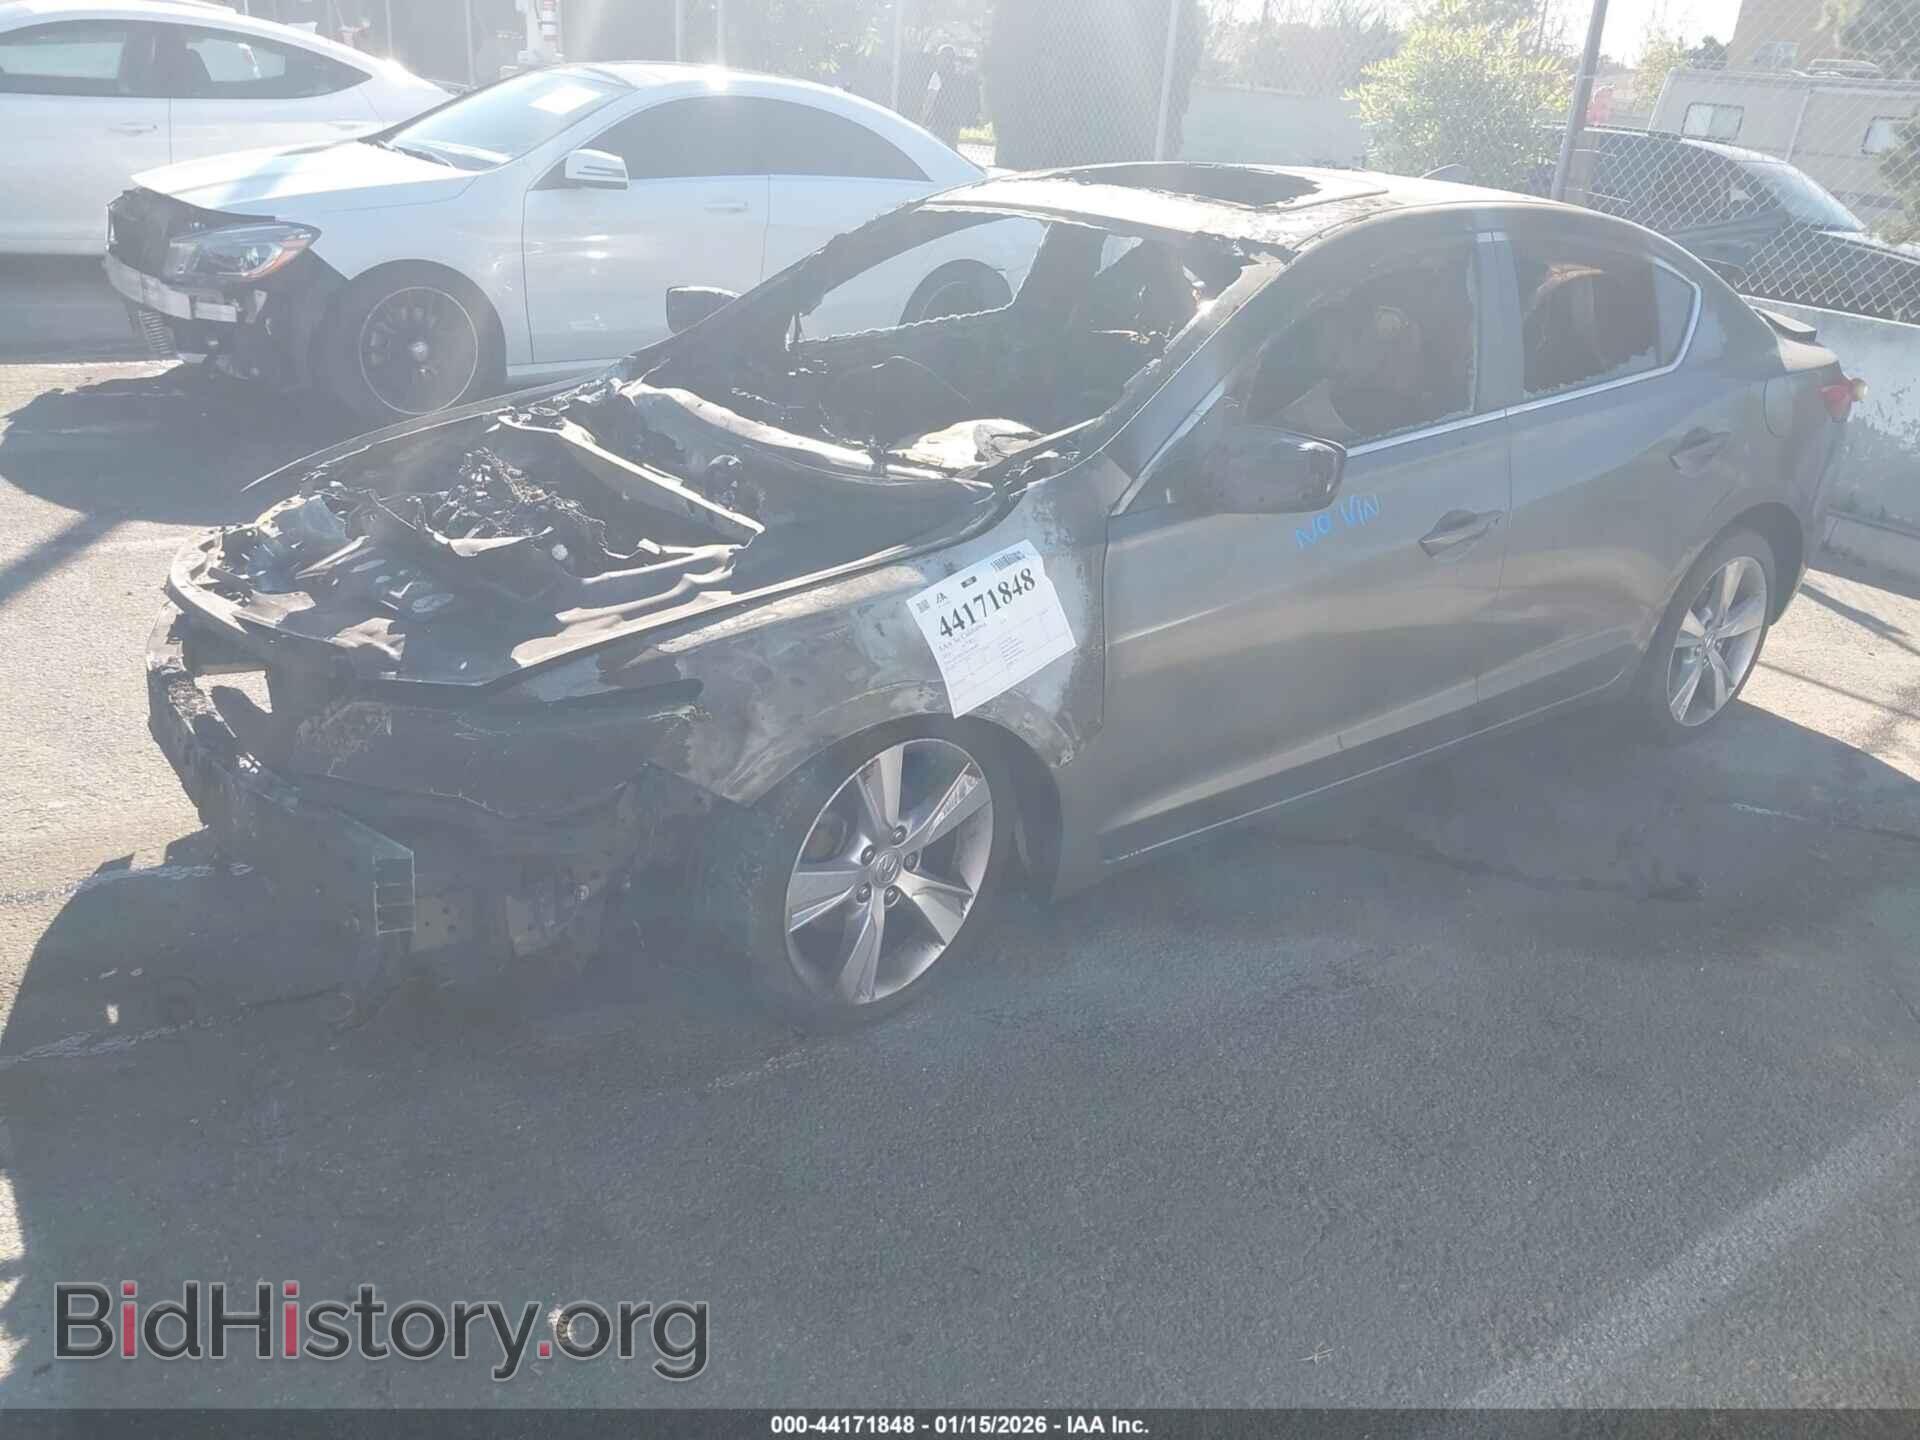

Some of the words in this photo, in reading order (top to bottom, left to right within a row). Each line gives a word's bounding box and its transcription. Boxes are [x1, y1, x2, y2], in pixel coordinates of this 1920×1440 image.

[1295, 513, 1331, 548] NO
[1339, 495, 1380, 526] VIN
[938, 568, 1036, 638] 44171848
